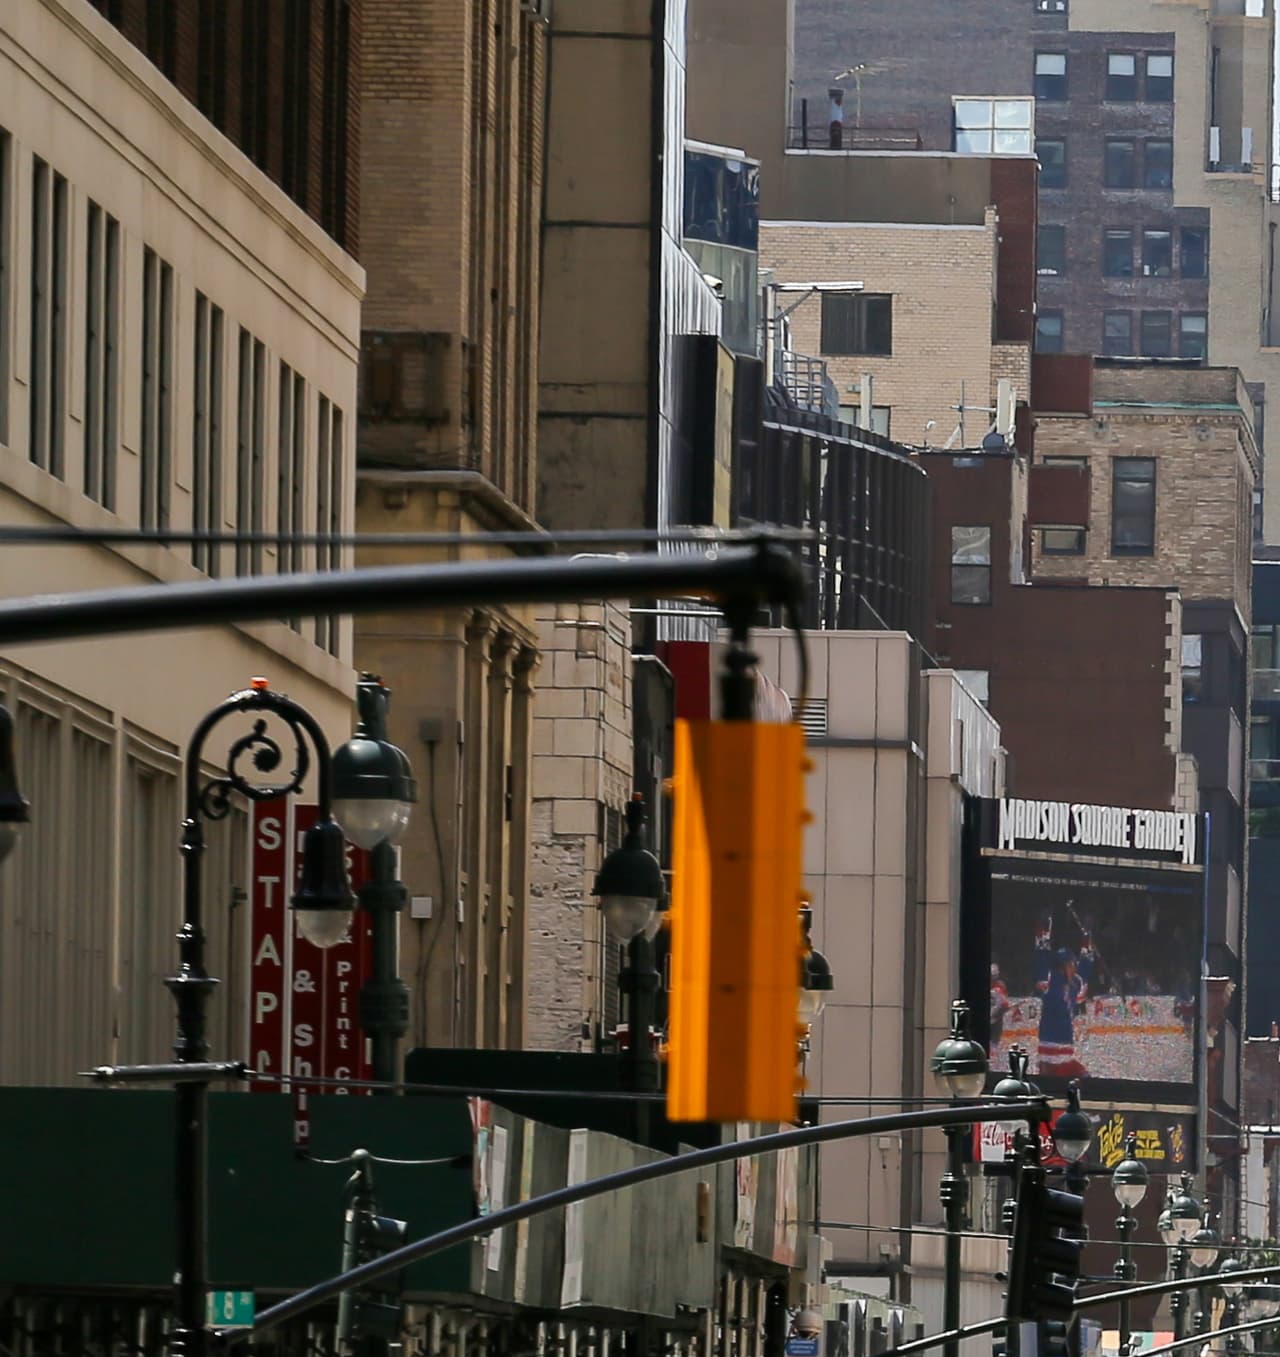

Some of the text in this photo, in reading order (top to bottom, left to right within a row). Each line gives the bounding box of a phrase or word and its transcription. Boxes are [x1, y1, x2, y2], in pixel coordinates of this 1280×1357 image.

[999, 798, 1196, 865] MADISON SQUARE GARDEN
